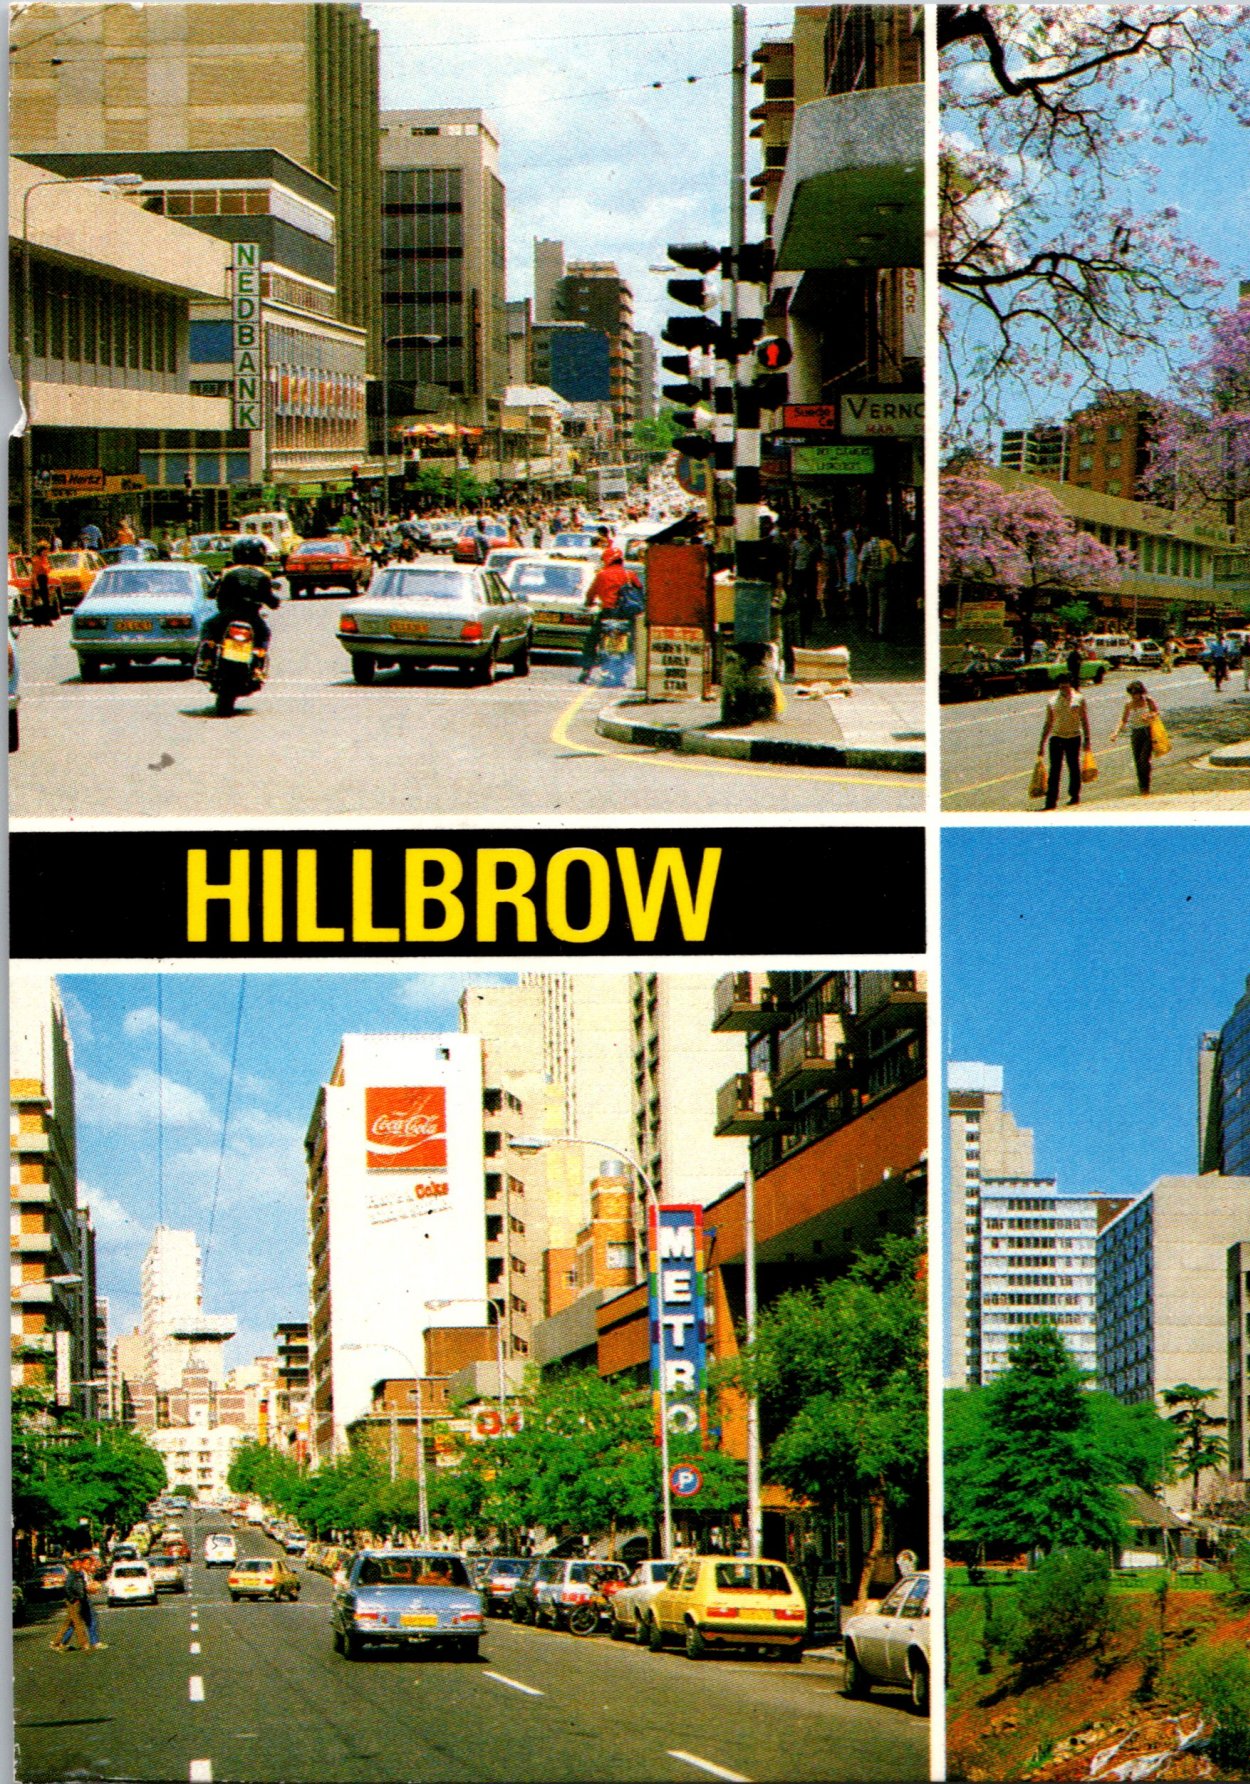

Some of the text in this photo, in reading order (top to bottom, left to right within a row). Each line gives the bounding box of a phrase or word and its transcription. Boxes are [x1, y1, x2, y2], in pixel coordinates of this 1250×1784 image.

[237, 244, 256, 428] NEDBANK
[415, 1182, 449, 1199] Coke
[658, 1223, 699, 1435] METRO
